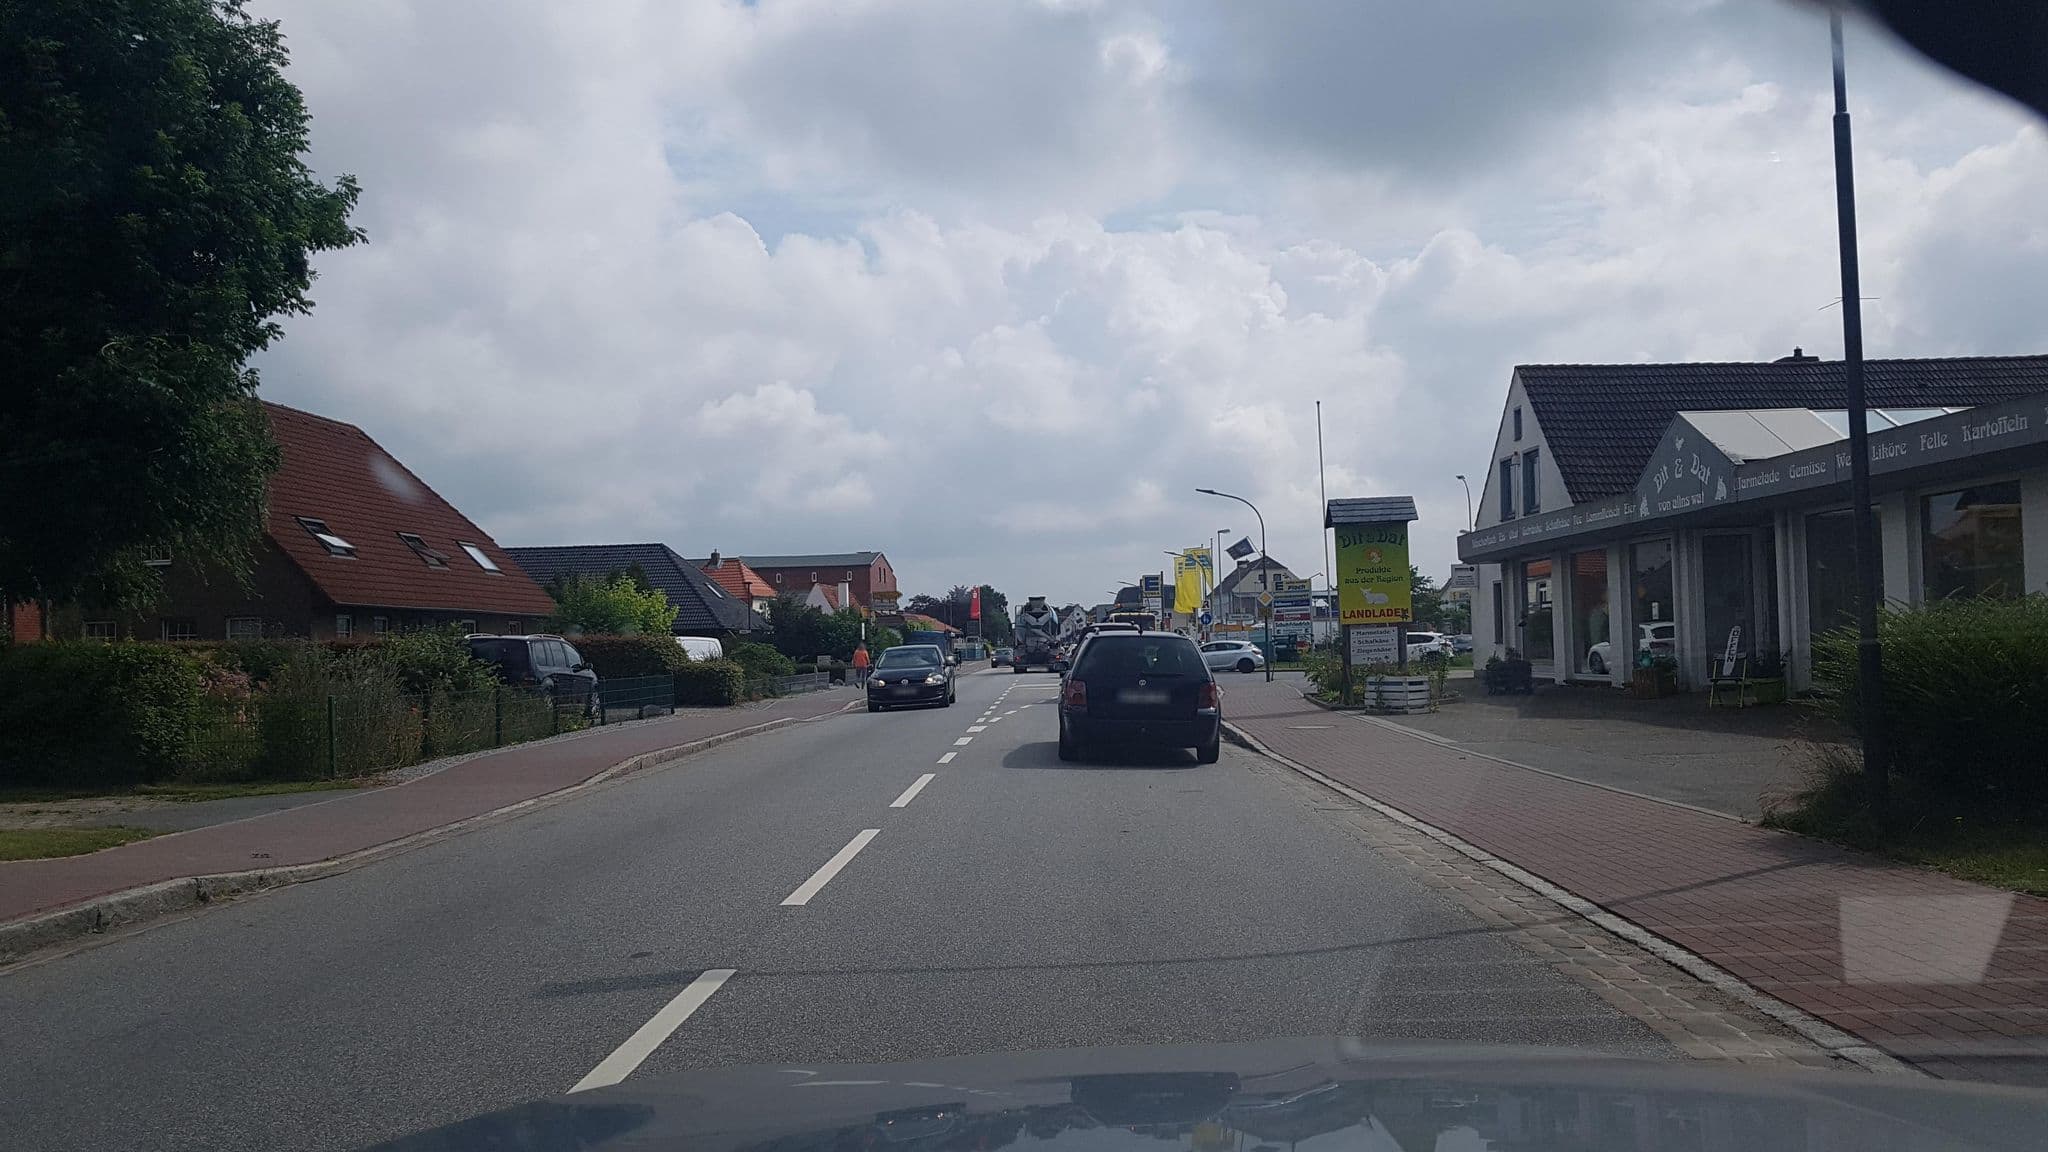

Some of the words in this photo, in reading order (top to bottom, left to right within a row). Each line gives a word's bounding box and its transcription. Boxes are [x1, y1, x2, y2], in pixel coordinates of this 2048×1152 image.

[1789, 460, 1826, 479] Gemüse
[1871, 441, 1907, 461] Liköre
[1920, 432, 1949, 450] Felle
[1962, 414, 2029, 442] Kartoffeln
[1653, 464, 1670, 493] Dit
[1674, 458, 1683, 479] &
[1690, 454, 1711, 485] Dat
[1355, 566, 1392, 574] Produkte
[1361, 575, 1374, 584] der
[1377, 575, 1404, 585] Region
[1342, 607, 1409, 620] LANDLADEN
